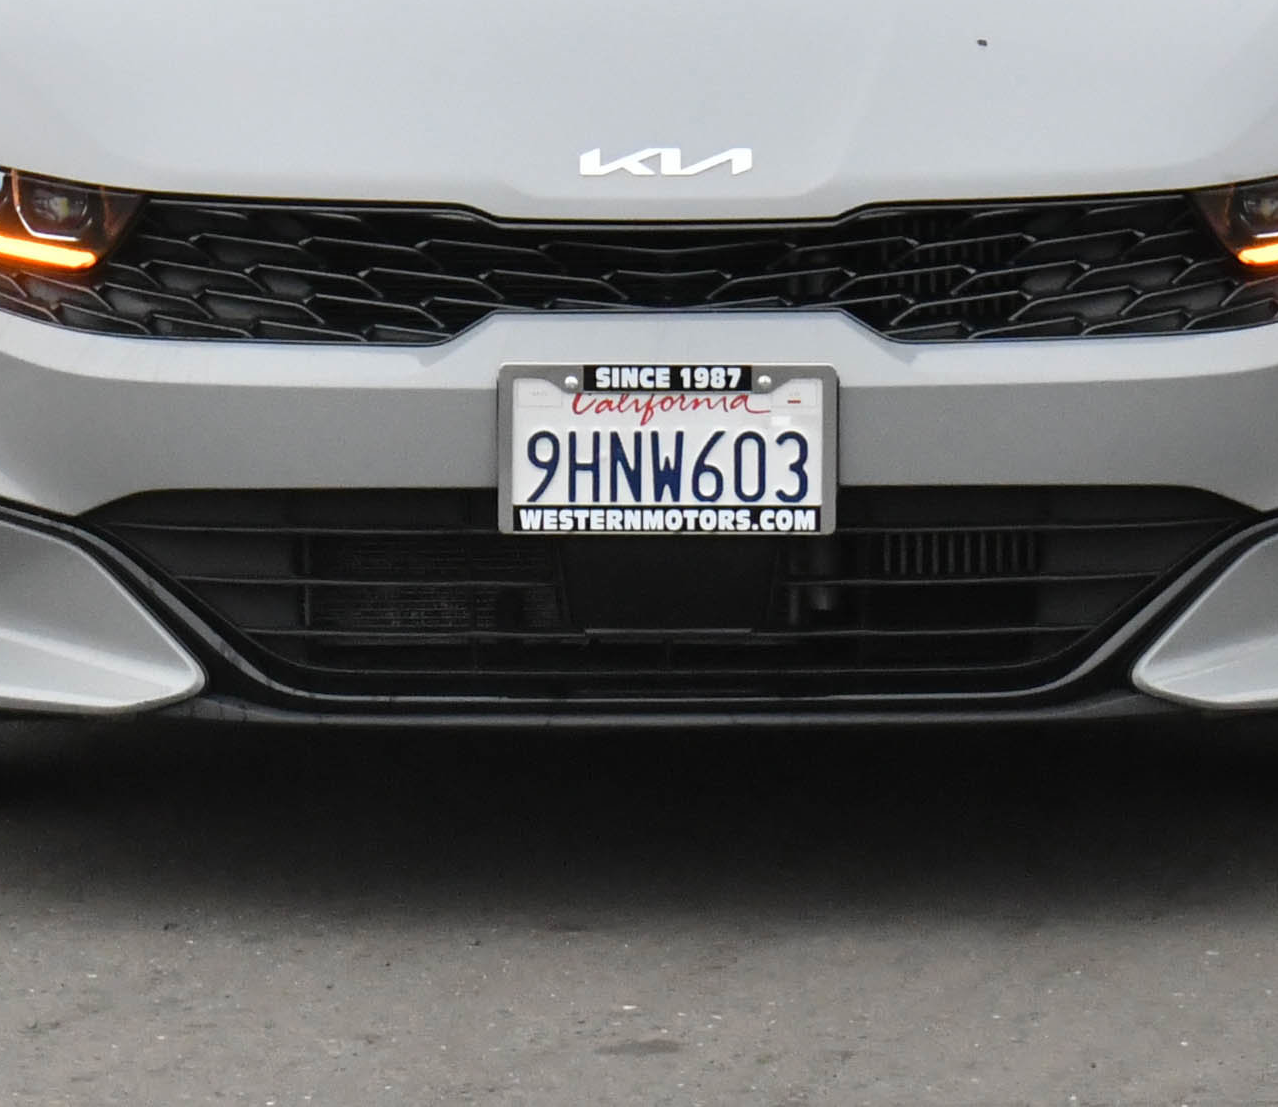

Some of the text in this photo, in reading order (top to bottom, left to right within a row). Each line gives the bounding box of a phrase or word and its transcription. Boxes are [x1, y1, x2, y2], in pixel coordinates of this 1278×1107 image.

[579, 147, 753, 176] KIA
[595, 366, 742, 390] SINCE 1987
[571, 392, 771, 427] California
[526, 429, 809, 504] 9HNW603
[519, 508, 817, 532] WESTERNMOTORS.COM
